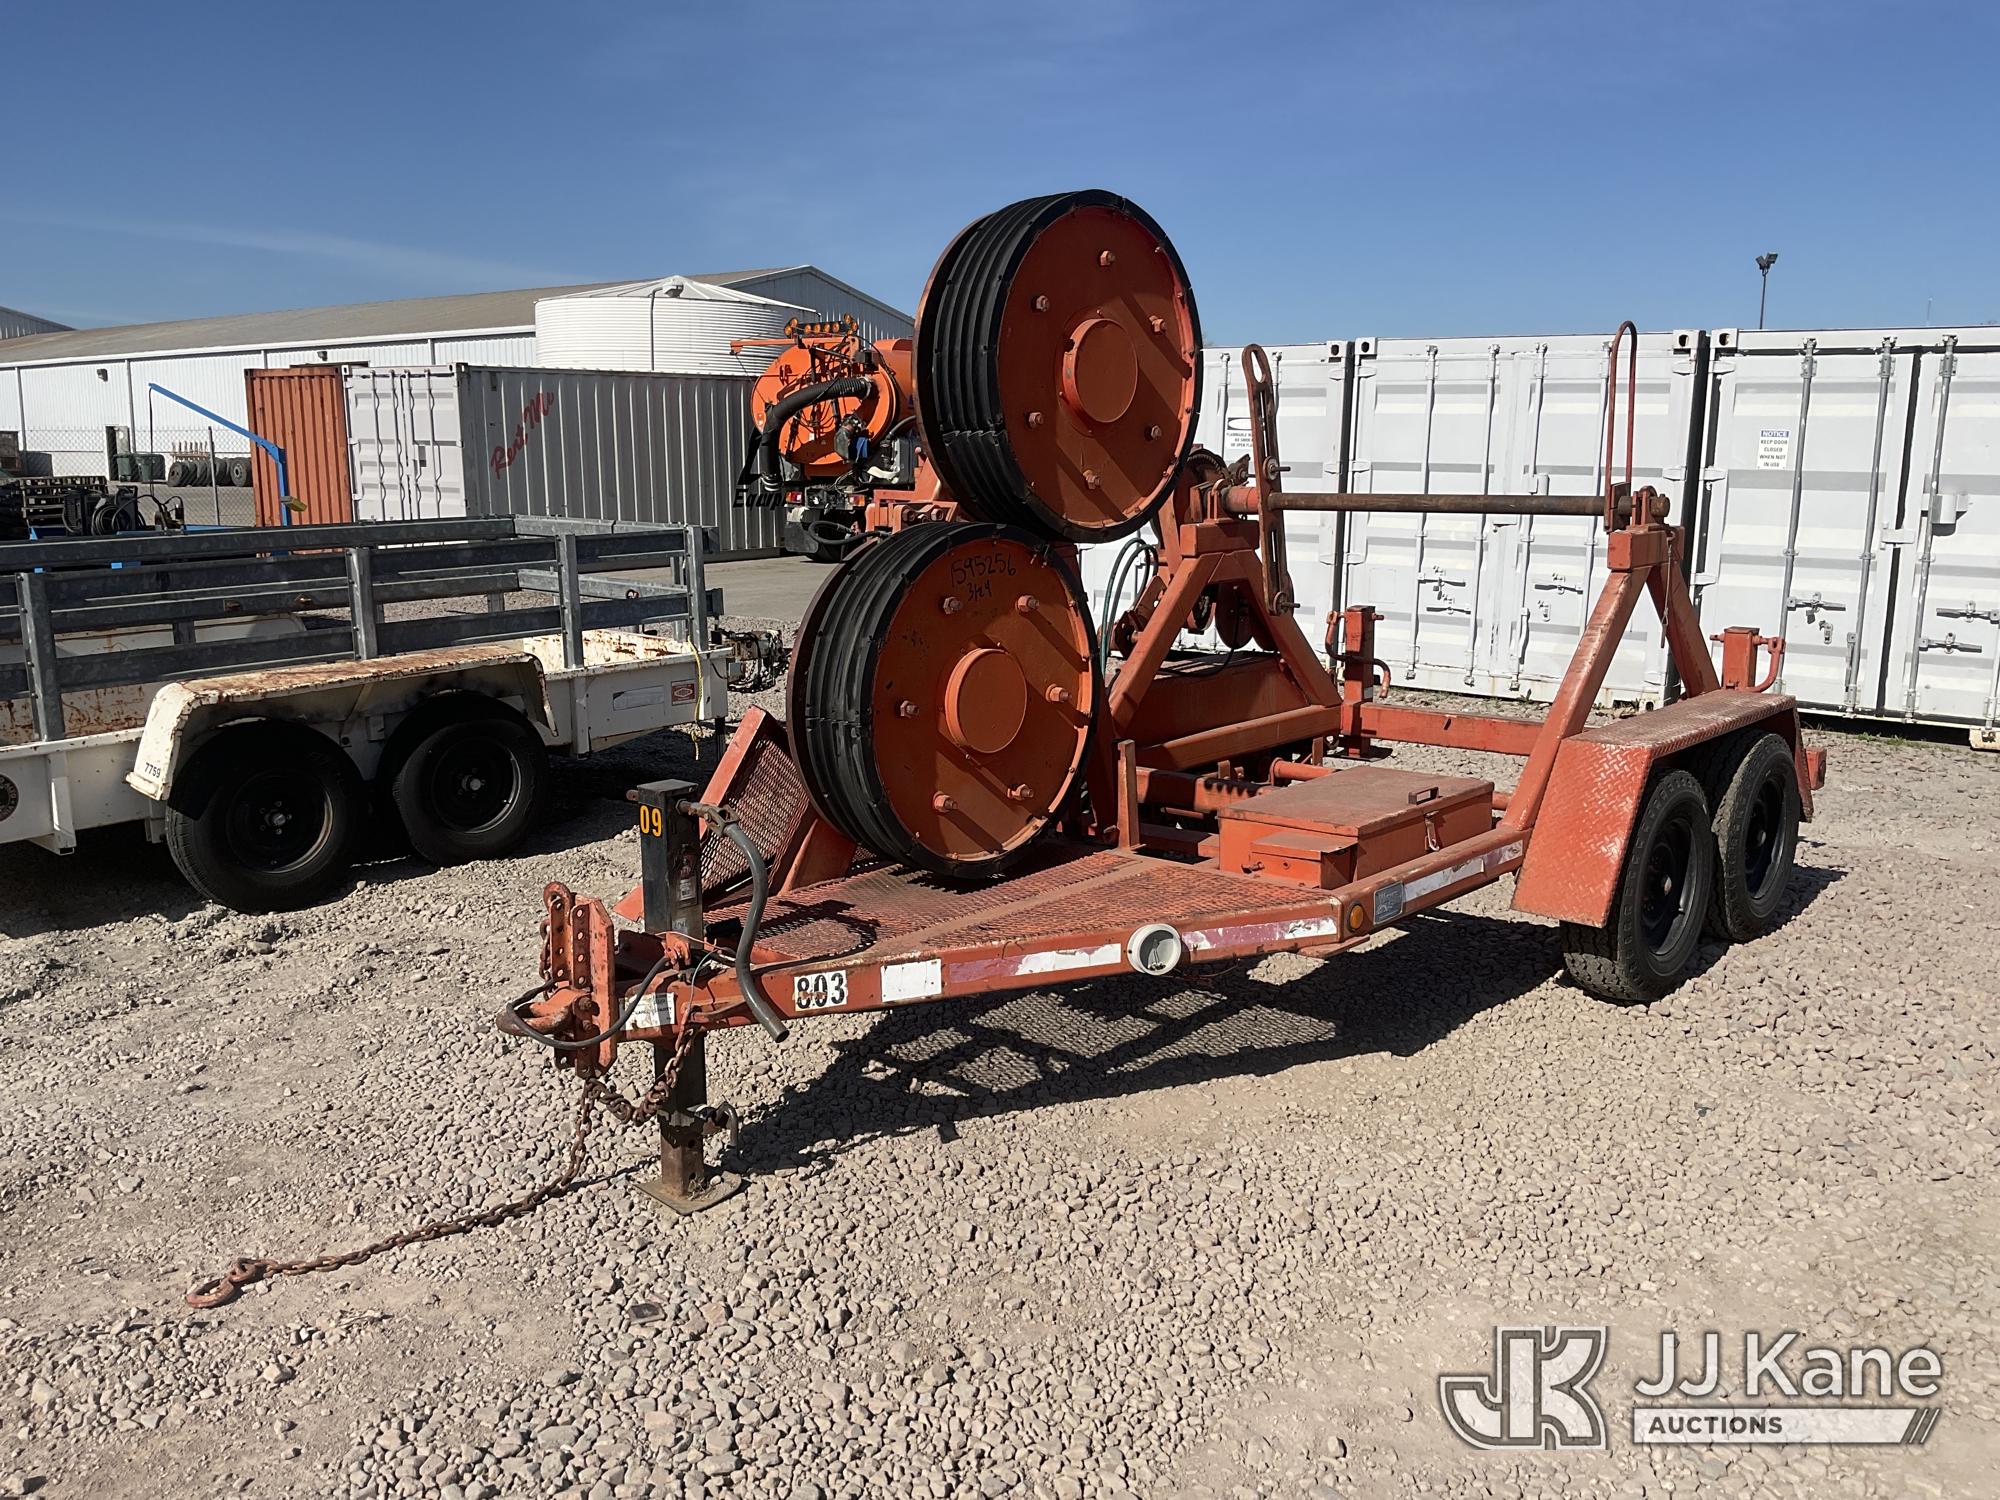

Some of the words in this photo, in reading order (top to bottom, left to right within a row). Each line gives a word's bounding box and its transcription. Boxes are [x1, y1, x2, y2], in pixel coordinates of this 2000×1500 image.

[145, 761, 161, 779] 7759
[640, 805, 662, 837] 09
[797, 972, 845, 1009] 803
